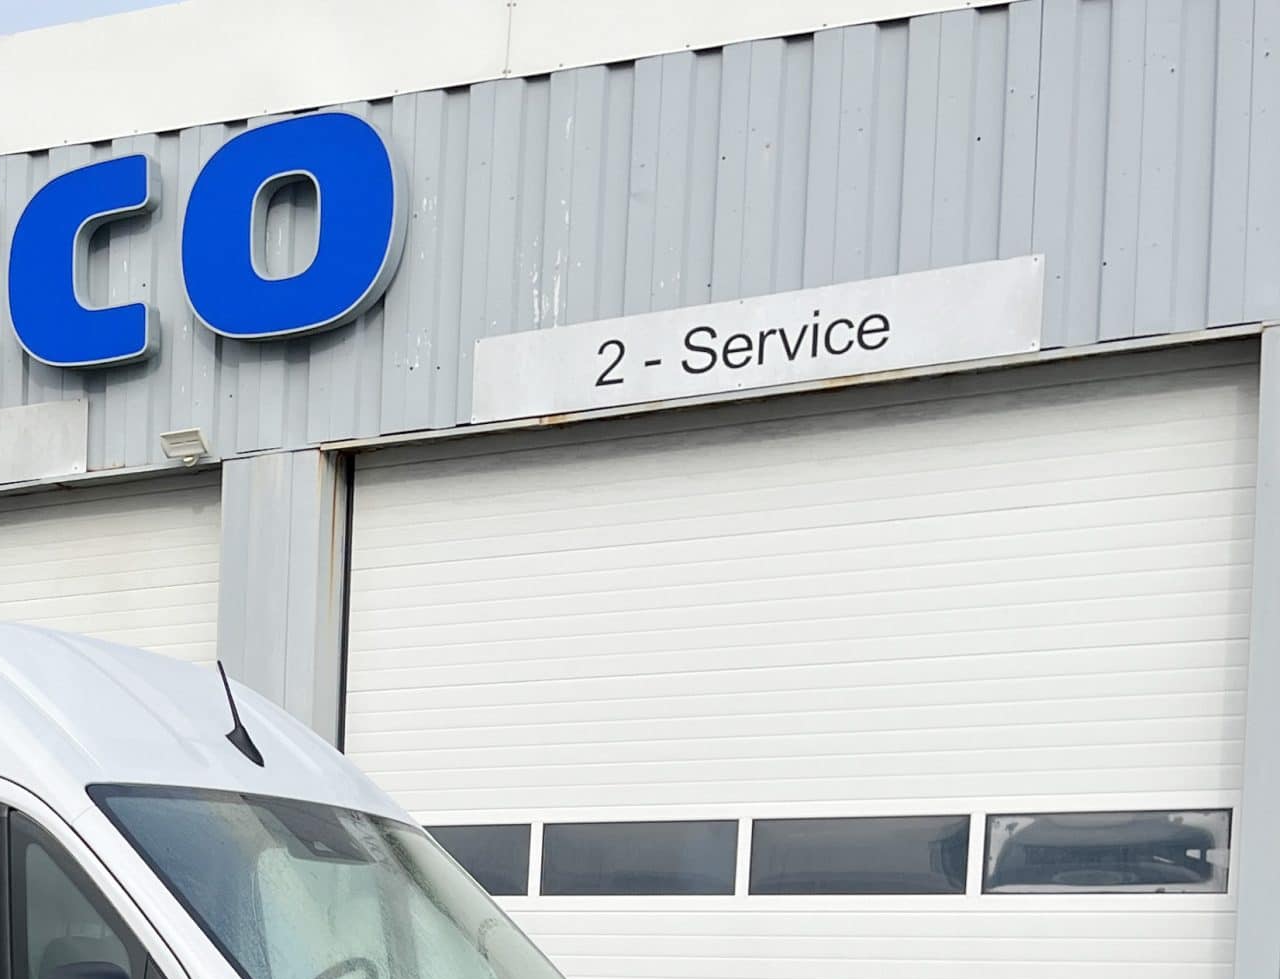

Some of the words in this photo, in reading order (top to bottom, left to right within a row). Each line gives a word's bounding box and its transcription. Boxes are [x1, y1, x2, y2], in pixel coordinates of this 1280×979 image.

[595, 340, 626, 387] 2
[643, 356, 663, 367] -
[680, 310, 891, 375] Service
